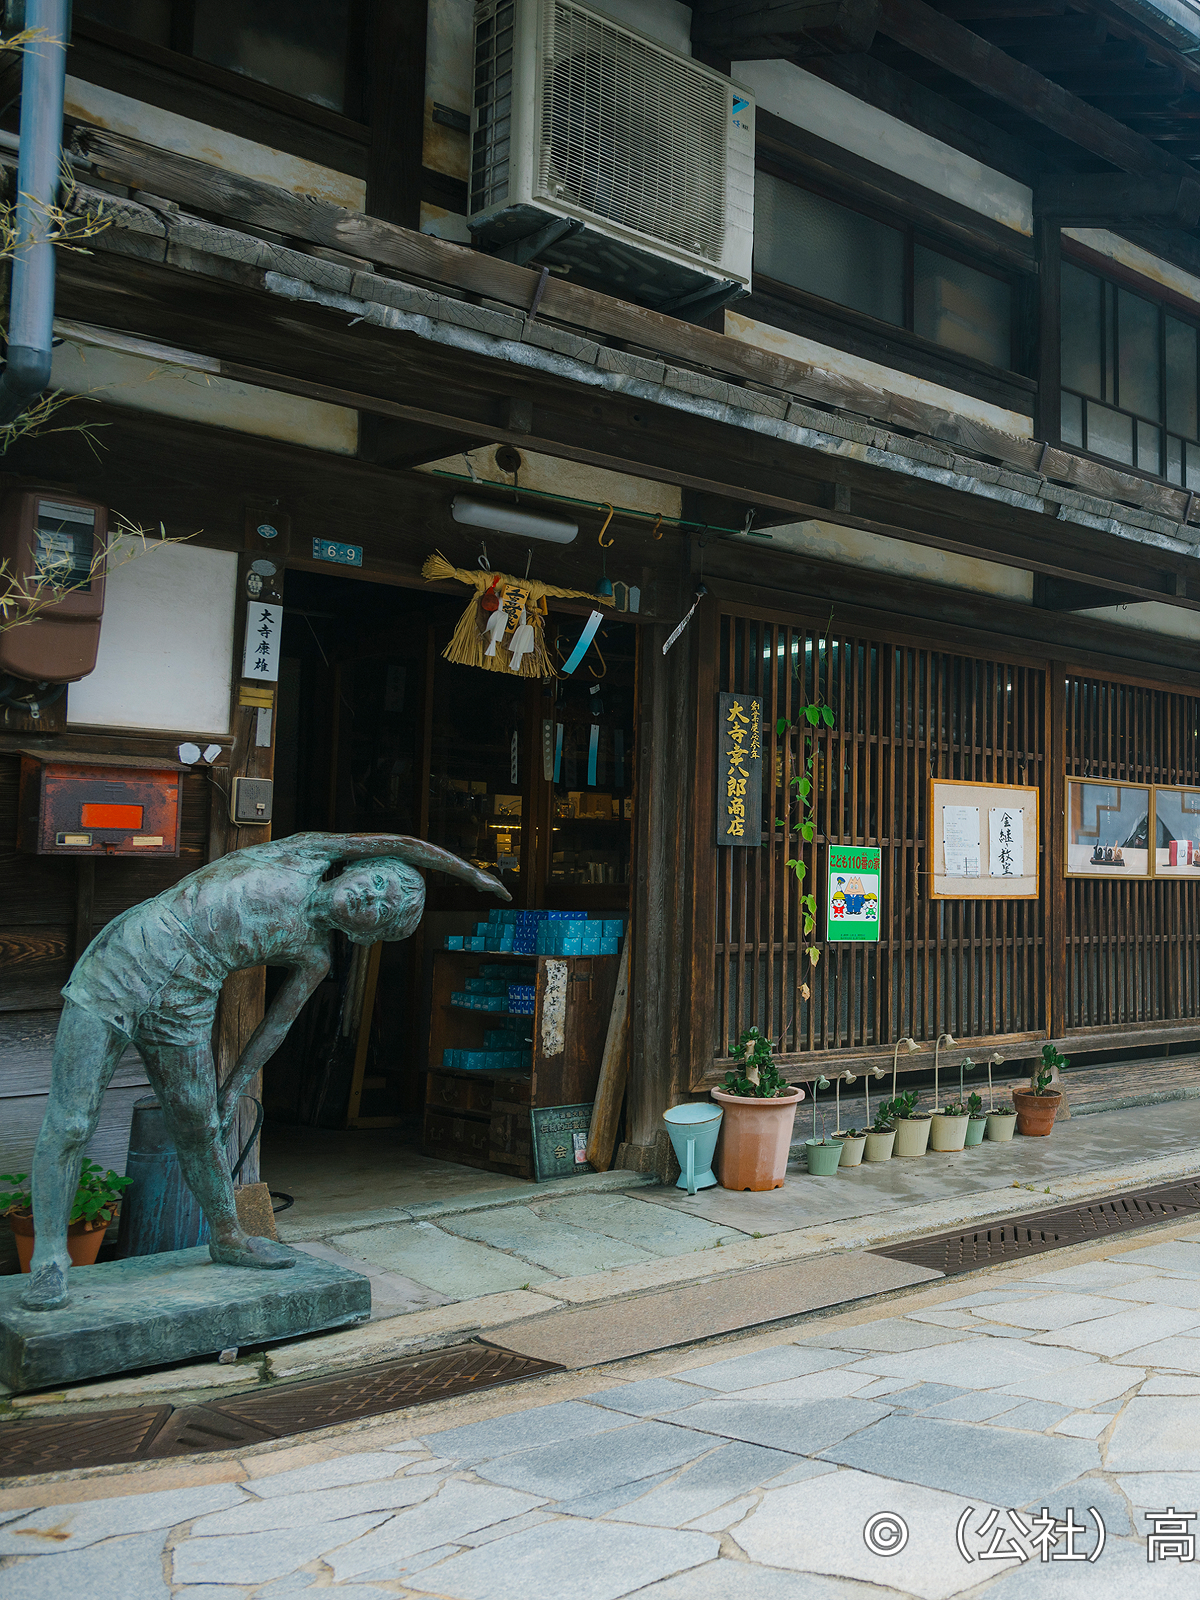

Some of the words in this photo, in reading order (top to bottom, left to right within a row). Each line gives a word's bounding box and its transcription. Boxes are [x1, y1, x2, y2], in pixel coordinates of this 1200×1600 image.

[253, 608, 275, 672] 大寺康雄
[727, 701, 750, 836] 大寺幸八郎商店
[830, 854, 880, 870] こども110番の家
